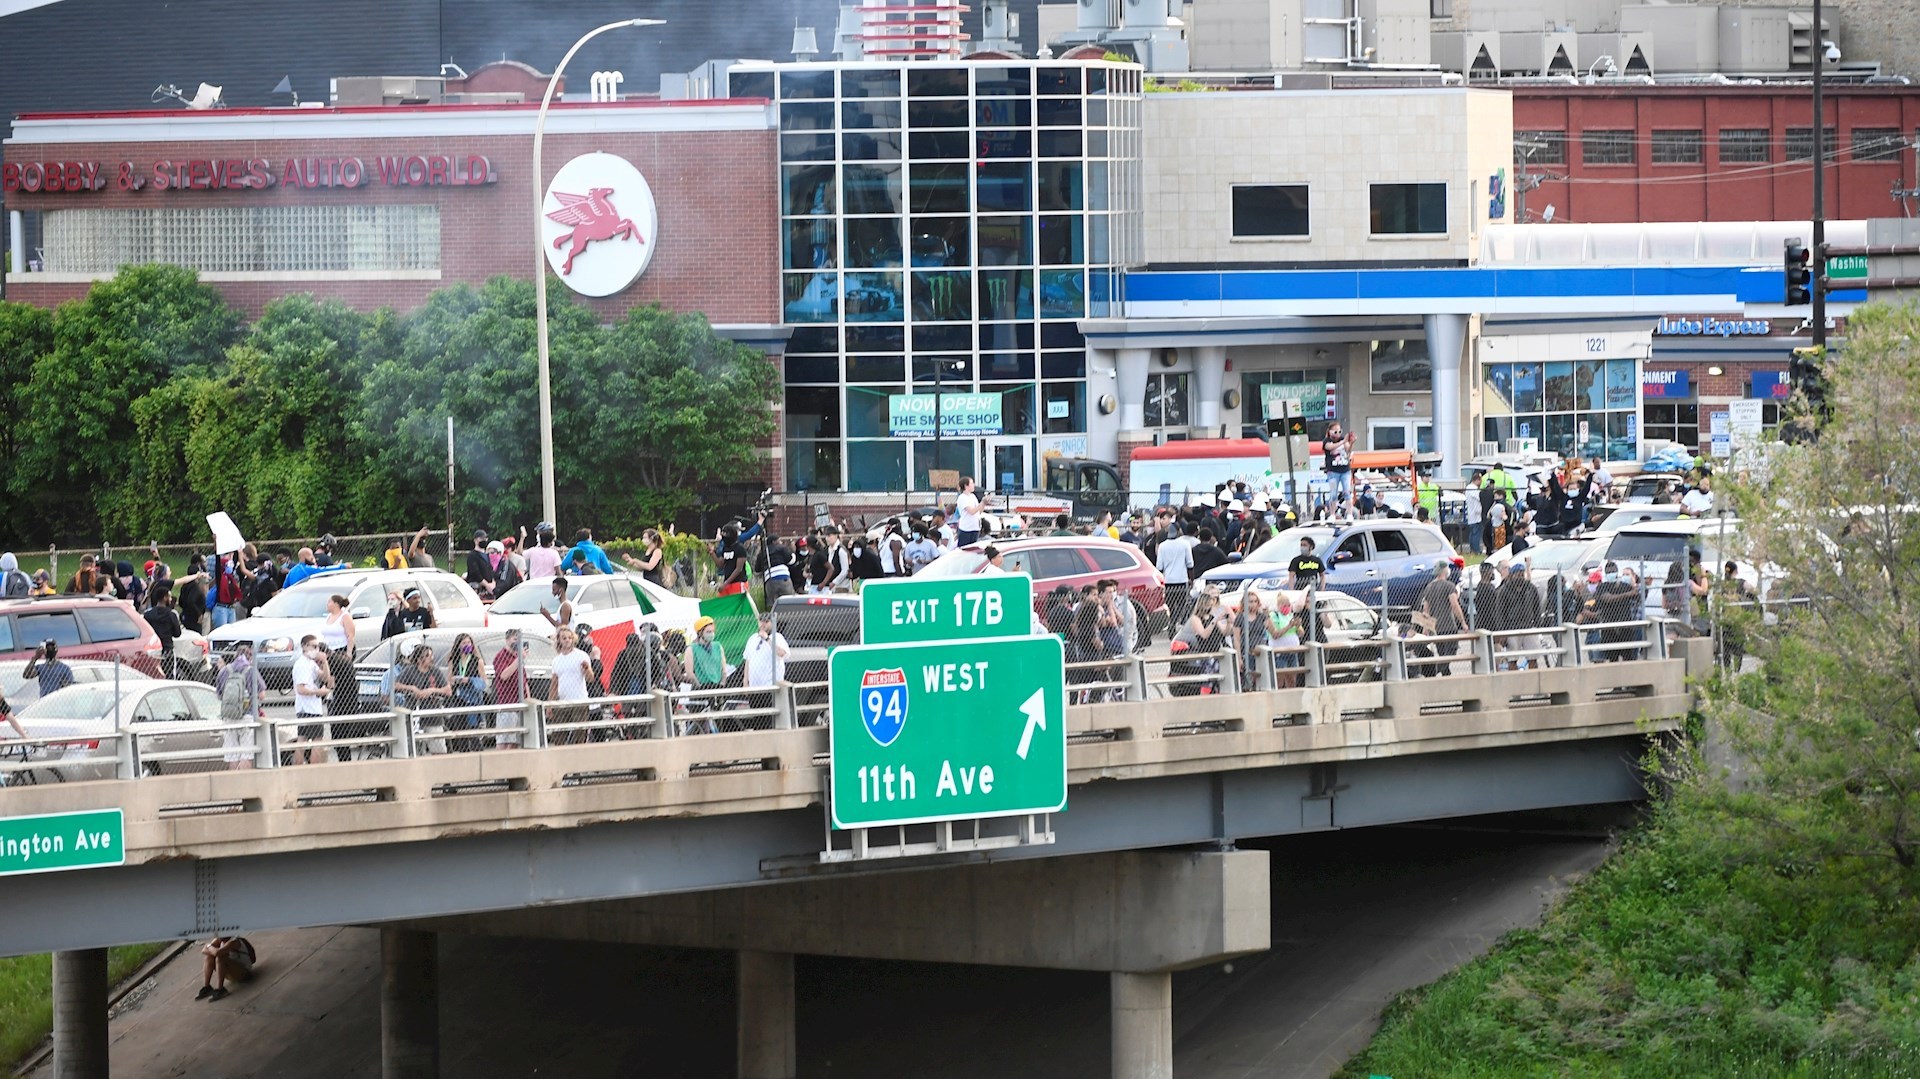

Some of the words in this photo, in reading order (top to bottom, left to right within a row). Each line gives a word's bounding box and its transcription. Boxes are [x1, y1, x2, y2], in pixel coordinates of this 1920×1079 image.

[3, 160, 101, 192] BOBBY
[117, 160, 135, 191] &
[152, 158, 269, 190] STEVE'S
[281, 156, 362, 188] AUTO
[376, 155, 488, 187] WORLD
[1659, 317, 1702, 335] Lube
[1702, 317, 1770, 338] Express
[1586, 338, 1606, 352] 1221
[1266, 387, 1289, 400] NOW
[1291, 385, 1321, 398] OPEN!
[899, 398, 937, 412] NOW
[943, 396, 994, 411] OPEN!
[1306, 401, 1326, 412] SHOP
[893, 415, 917, 426] THE
[920, 414, 964, 425] SMOKE
[967, 414, 1000, 425] SHOP
[894, 430, 922, 438] Providing
[1061, 437, 1086, 453] SNACK
[891, 599, 939, 625] EXIT
[953, 590, 1004, 627] 17B
[867, 673, 900, 685] INTERSTATE
[922, 661, 988, 694] WEST
[867, 689, 902, 726] 94
[857, 764, 916, 803] 11th
[935, 759, 995, 798] Ave
[74, 829, 111, 851] Ave
